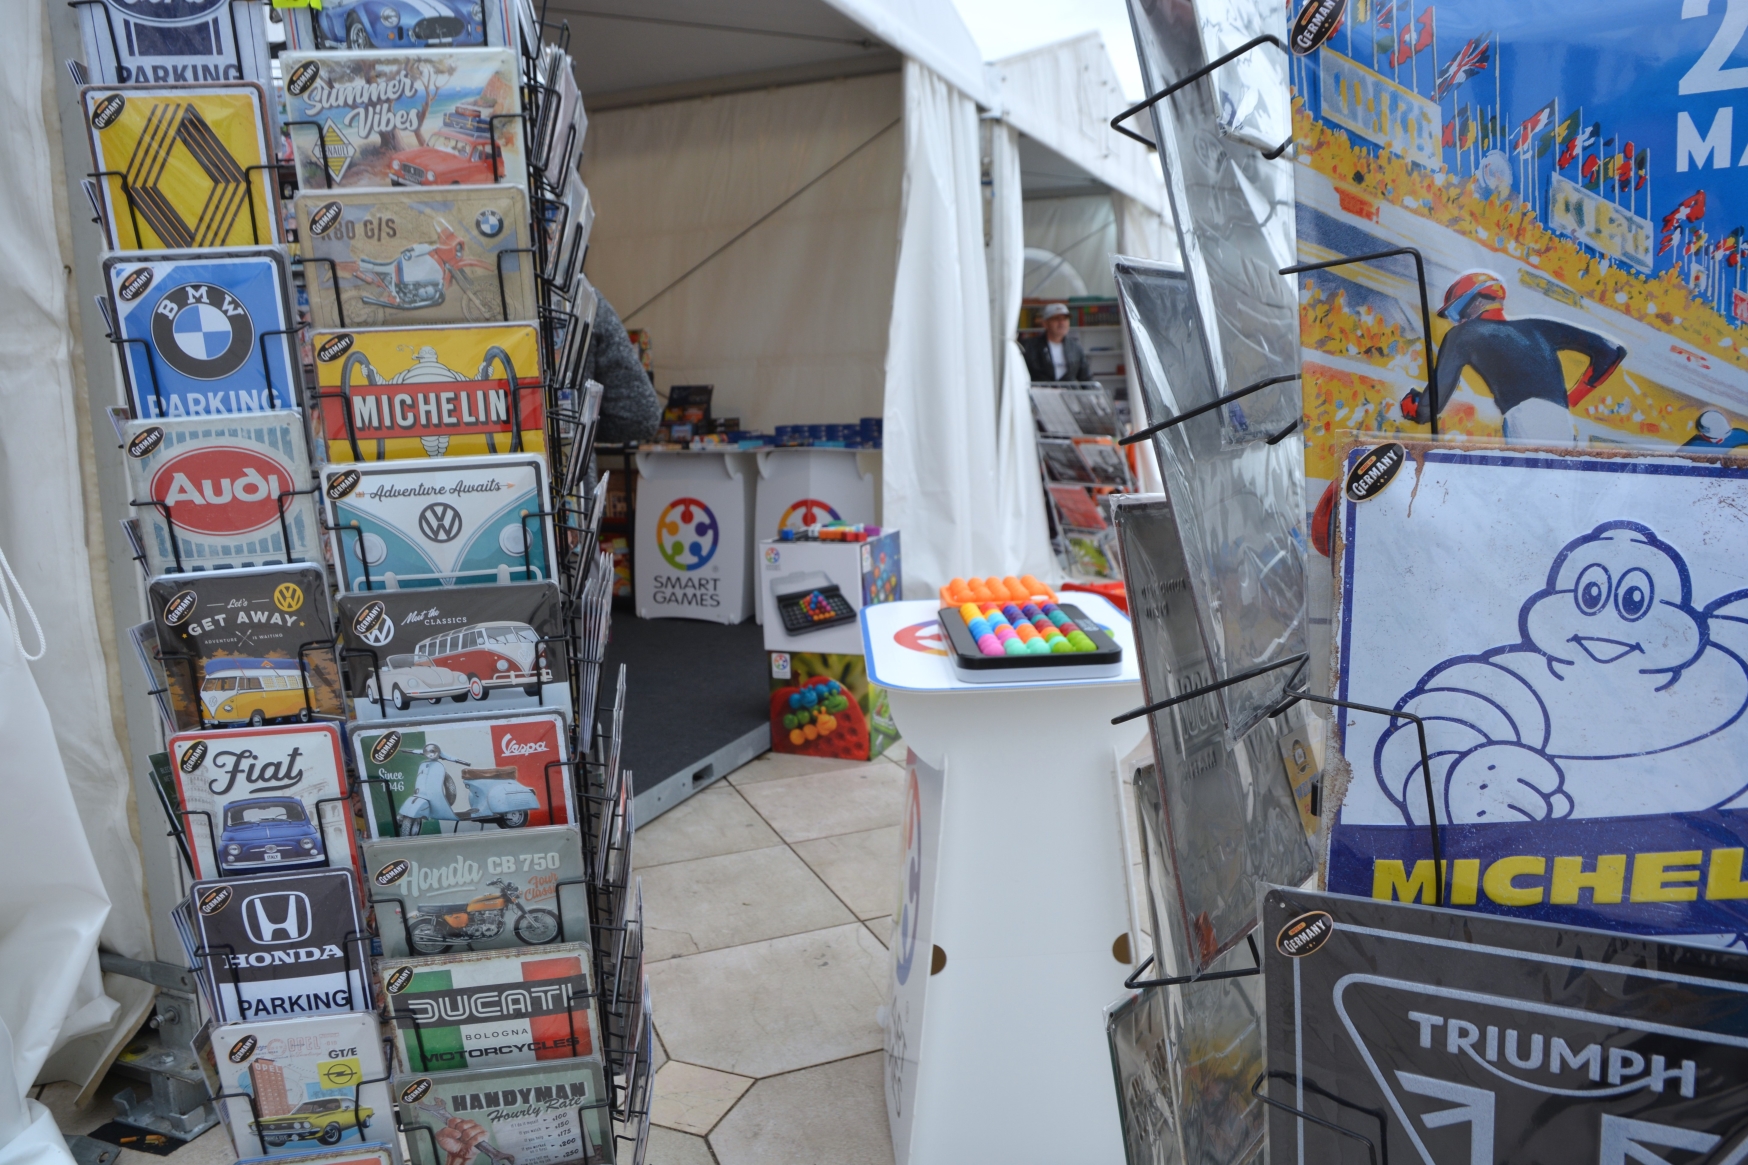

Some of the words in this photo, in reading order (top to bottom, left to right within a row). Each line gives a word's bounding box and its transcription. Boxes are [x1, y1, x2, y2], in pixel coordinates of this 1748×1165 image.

[1297, 0, 1335, 47] GERMAN
[115, 63, 242, 83] PARKING
[290, 64, 318, 95] GERMANY
[304, 70, 417, 116] Summer
[95, 98, 122, 127] GERMANY
[343, 104, 420, 139] Vibes
[1676, 106, 1748, 172] M
[312, 205, 339, 234] GERMANY
[364, 217, 397, 242] G/S
[122, 271, 150, 300] GERMANY
[158, 286, 244, 320] BMW
[320, 336, 350, 361] GERMANY
[147, 388, 282, 419] PARKING
[352, 388, 510, 430] MICHELIN
[131, 430, 161, 456] GERMANY
[331, 473, 357, 498] GERMANY
[1352, 450, 1397, 496] GERMANY
[164, 467, 280, 507] Audi
[370, 482, 447, 502] Adventure
[449, 478, 502, 498] Awaits
[653, 575, 720, 592] SMART
[168, 595, 193, 622] GERMANY
[227, 598, 248, 609] Let's
[653, 590, 720, 608] GAMES
[188, 614, 227, 636] GET
[237, 611, 298, 627] AWAY
[356, 605, 381, 633] GERMANY
[401, 611, 426, 626] Meet
[427, 606, 440, 617] the
[425, 616, 467, 626] CLASSICS
[183, 743, 205, 772] GERMANY
[375, 735, 399, 761] GERMANY
[501, 733, 549, 757] Vespa
[208, 747, 303, 796] Fiat
[378, 768, 404, 780] Since
[379, 862, 406, 884] GERMANY
[396, 856, 483, 897] Honda
[487, 856, 516, 875] CB
[520, 852, 560, 872] 750
[528, 872, 558, 889] Four
[203, 890, 228, 913] GERMANY
[524, 885, 561, 902] Classi
[1284, 919, 1326, 953] GERMANY
[223, 944, 344, 969] HONDA
[389, 968, 411, 993] GERMANY
[240, 989, 350, 1019] PARKING
[408, 983, 574, 1023] DUCATI
[465, 1028, 529, 1041] BOLOGNA
[232, 1038, 254, 1063] GERMANY
[328, 1047, 357, 1059] GT/E
[420, 1036, 580, 1064] MOTORCYCLES
[1408, 1011, 1696, 1098] TRIUMPH
[255, 1063, 281, 1073] OPEL
[405, 1082, 428, 1102] GERMANY
[451, 1082, 588, 1112] HANDYMAN
[487, 1105, 541, 1123] Hourly
[546, 1097, 583, 1113] Rate
